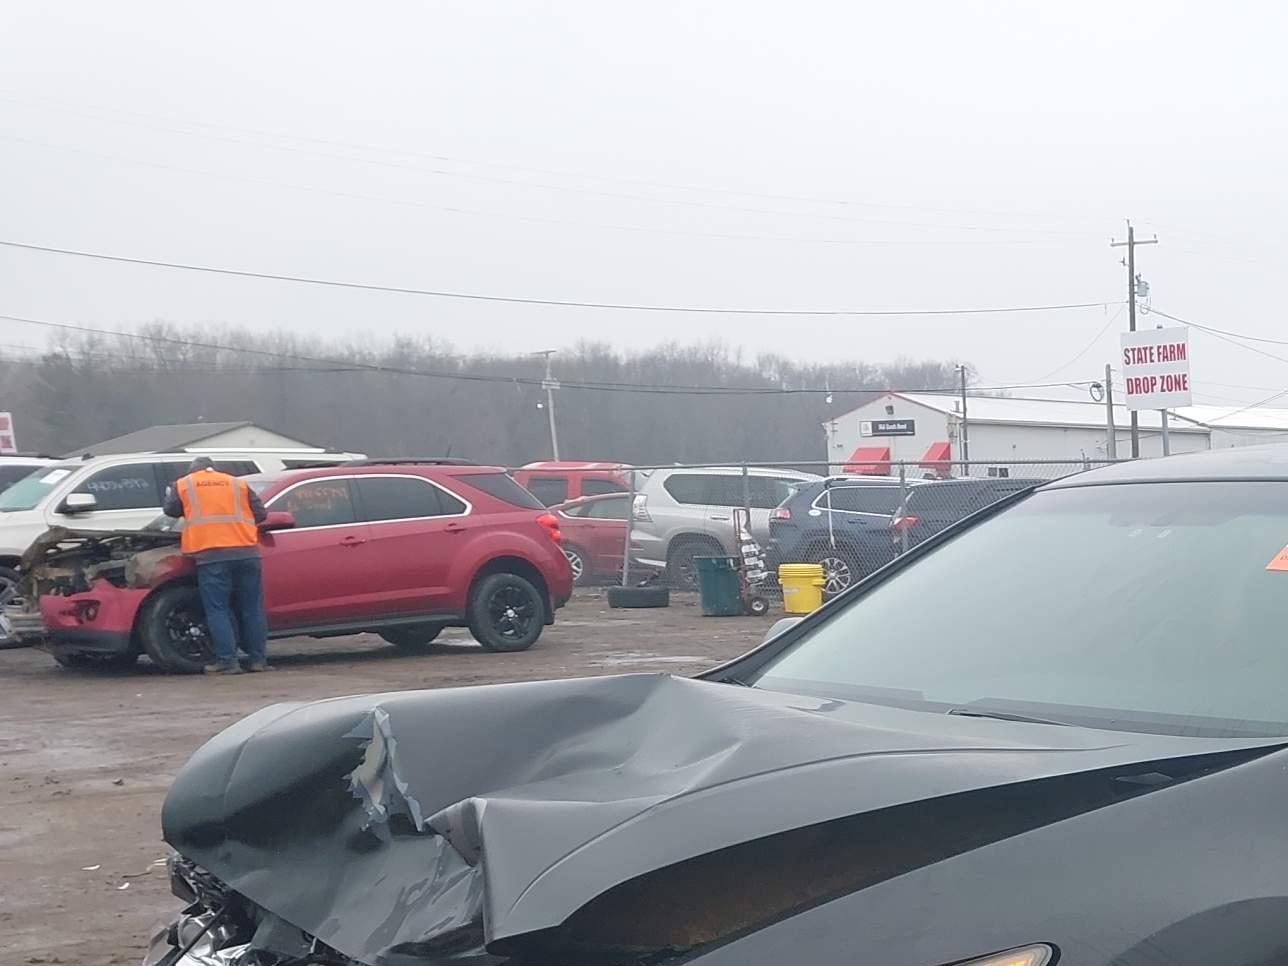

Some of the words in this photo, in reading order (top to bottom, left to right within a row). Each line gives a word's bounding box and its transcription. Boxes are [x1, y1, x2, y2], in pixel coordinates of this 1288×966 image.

[1123, 346, 1155, 365] STATE
[1156, 343, 1186, 363] FARM
[1126, 376, 1157, 395] DROP
[1159, 373, 1188, 393] ZONE
